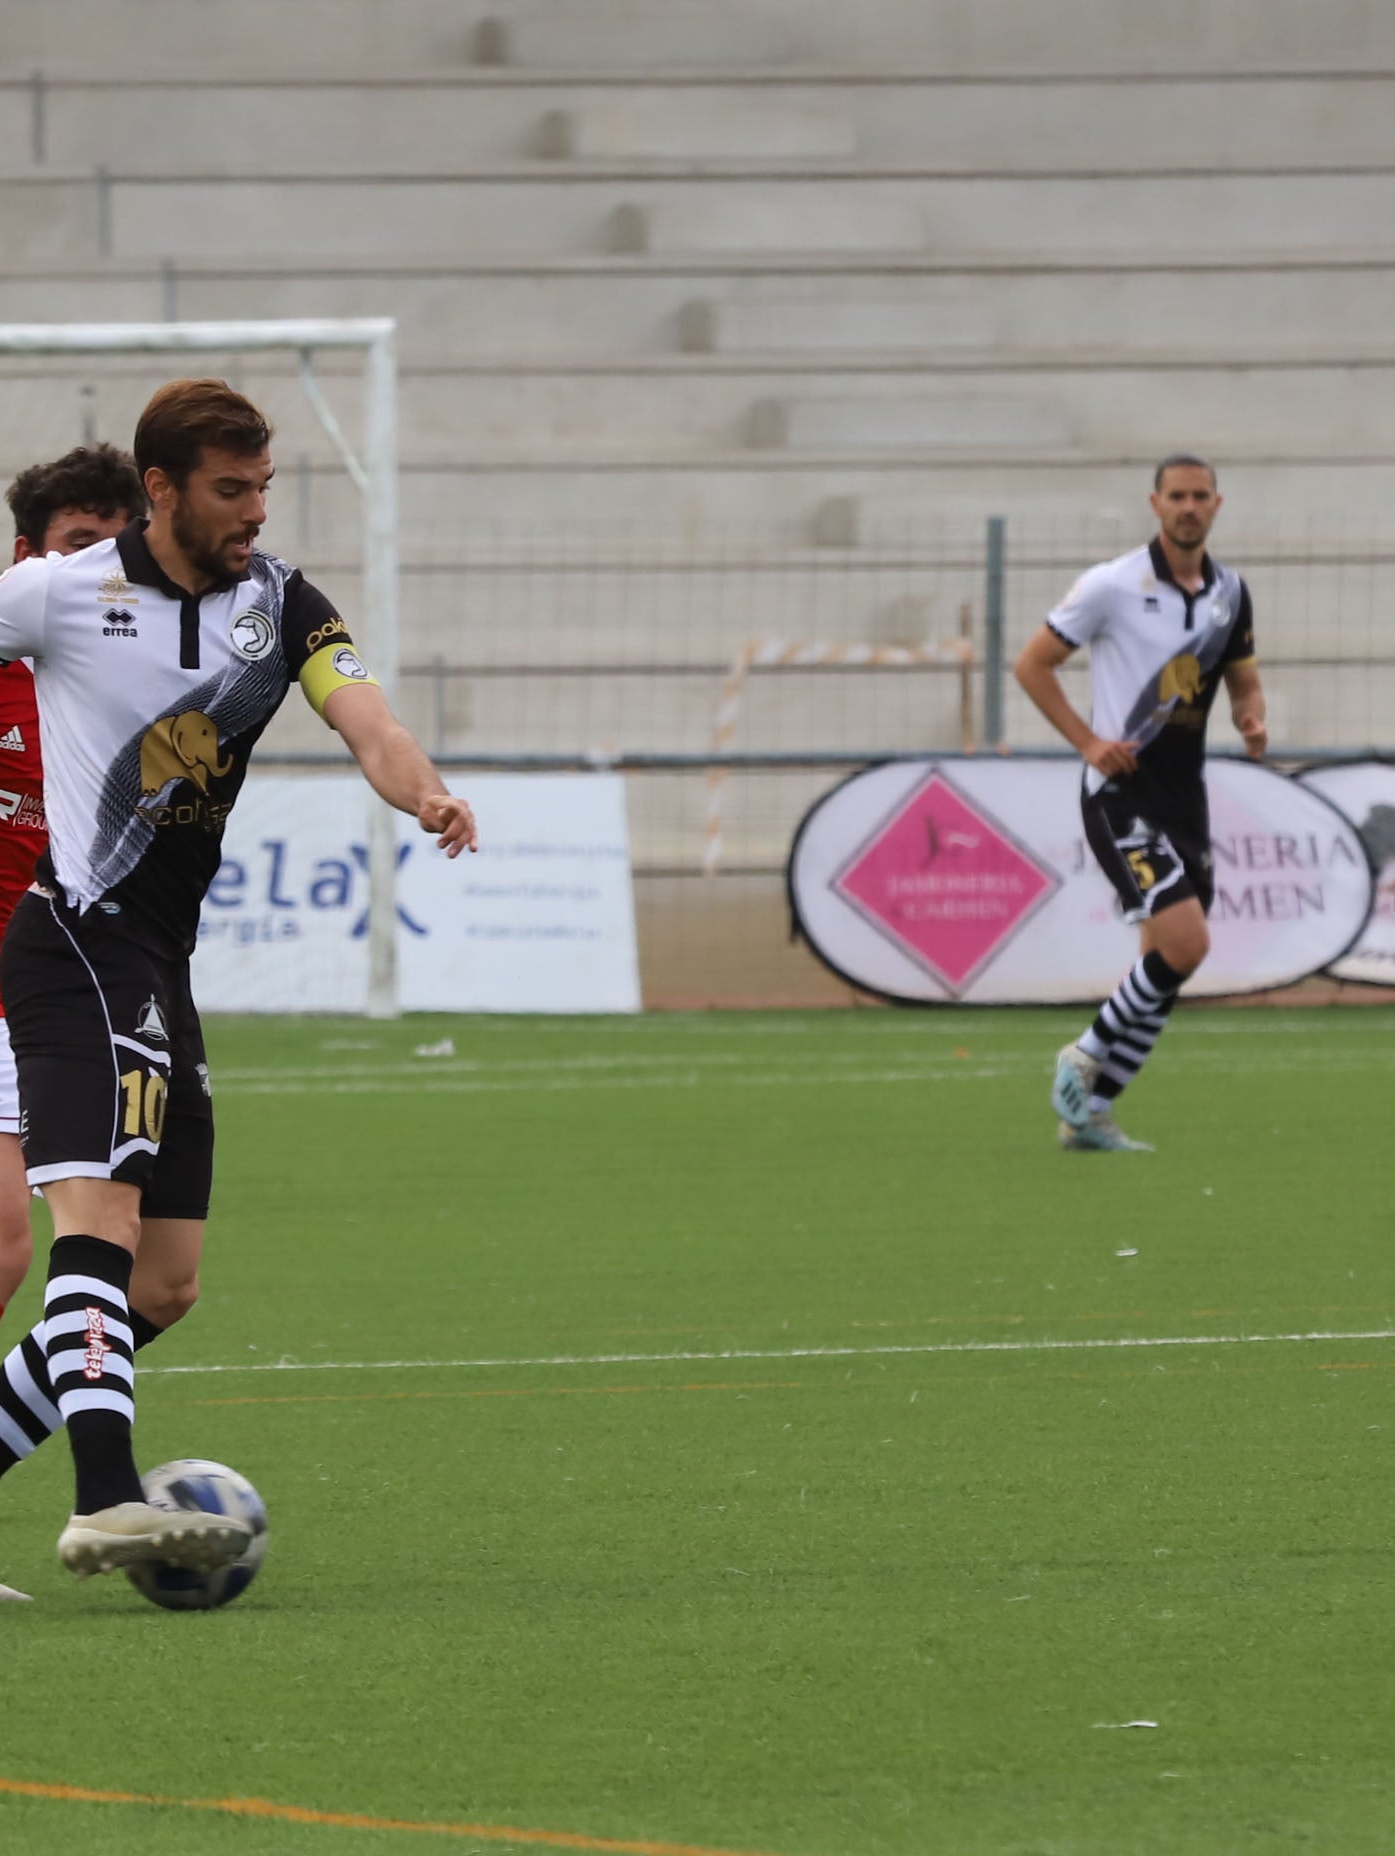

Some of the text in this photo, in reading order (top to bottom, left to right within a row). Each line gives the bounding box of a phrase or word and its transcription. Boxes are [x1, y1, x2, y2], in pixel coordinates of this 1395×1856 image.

[102, 627, 138, 637] errea
[16, 811, 48, 831] GROU
[1127, 850, 1155, 890] 5
[120, 1069, 167, 1143] 10
